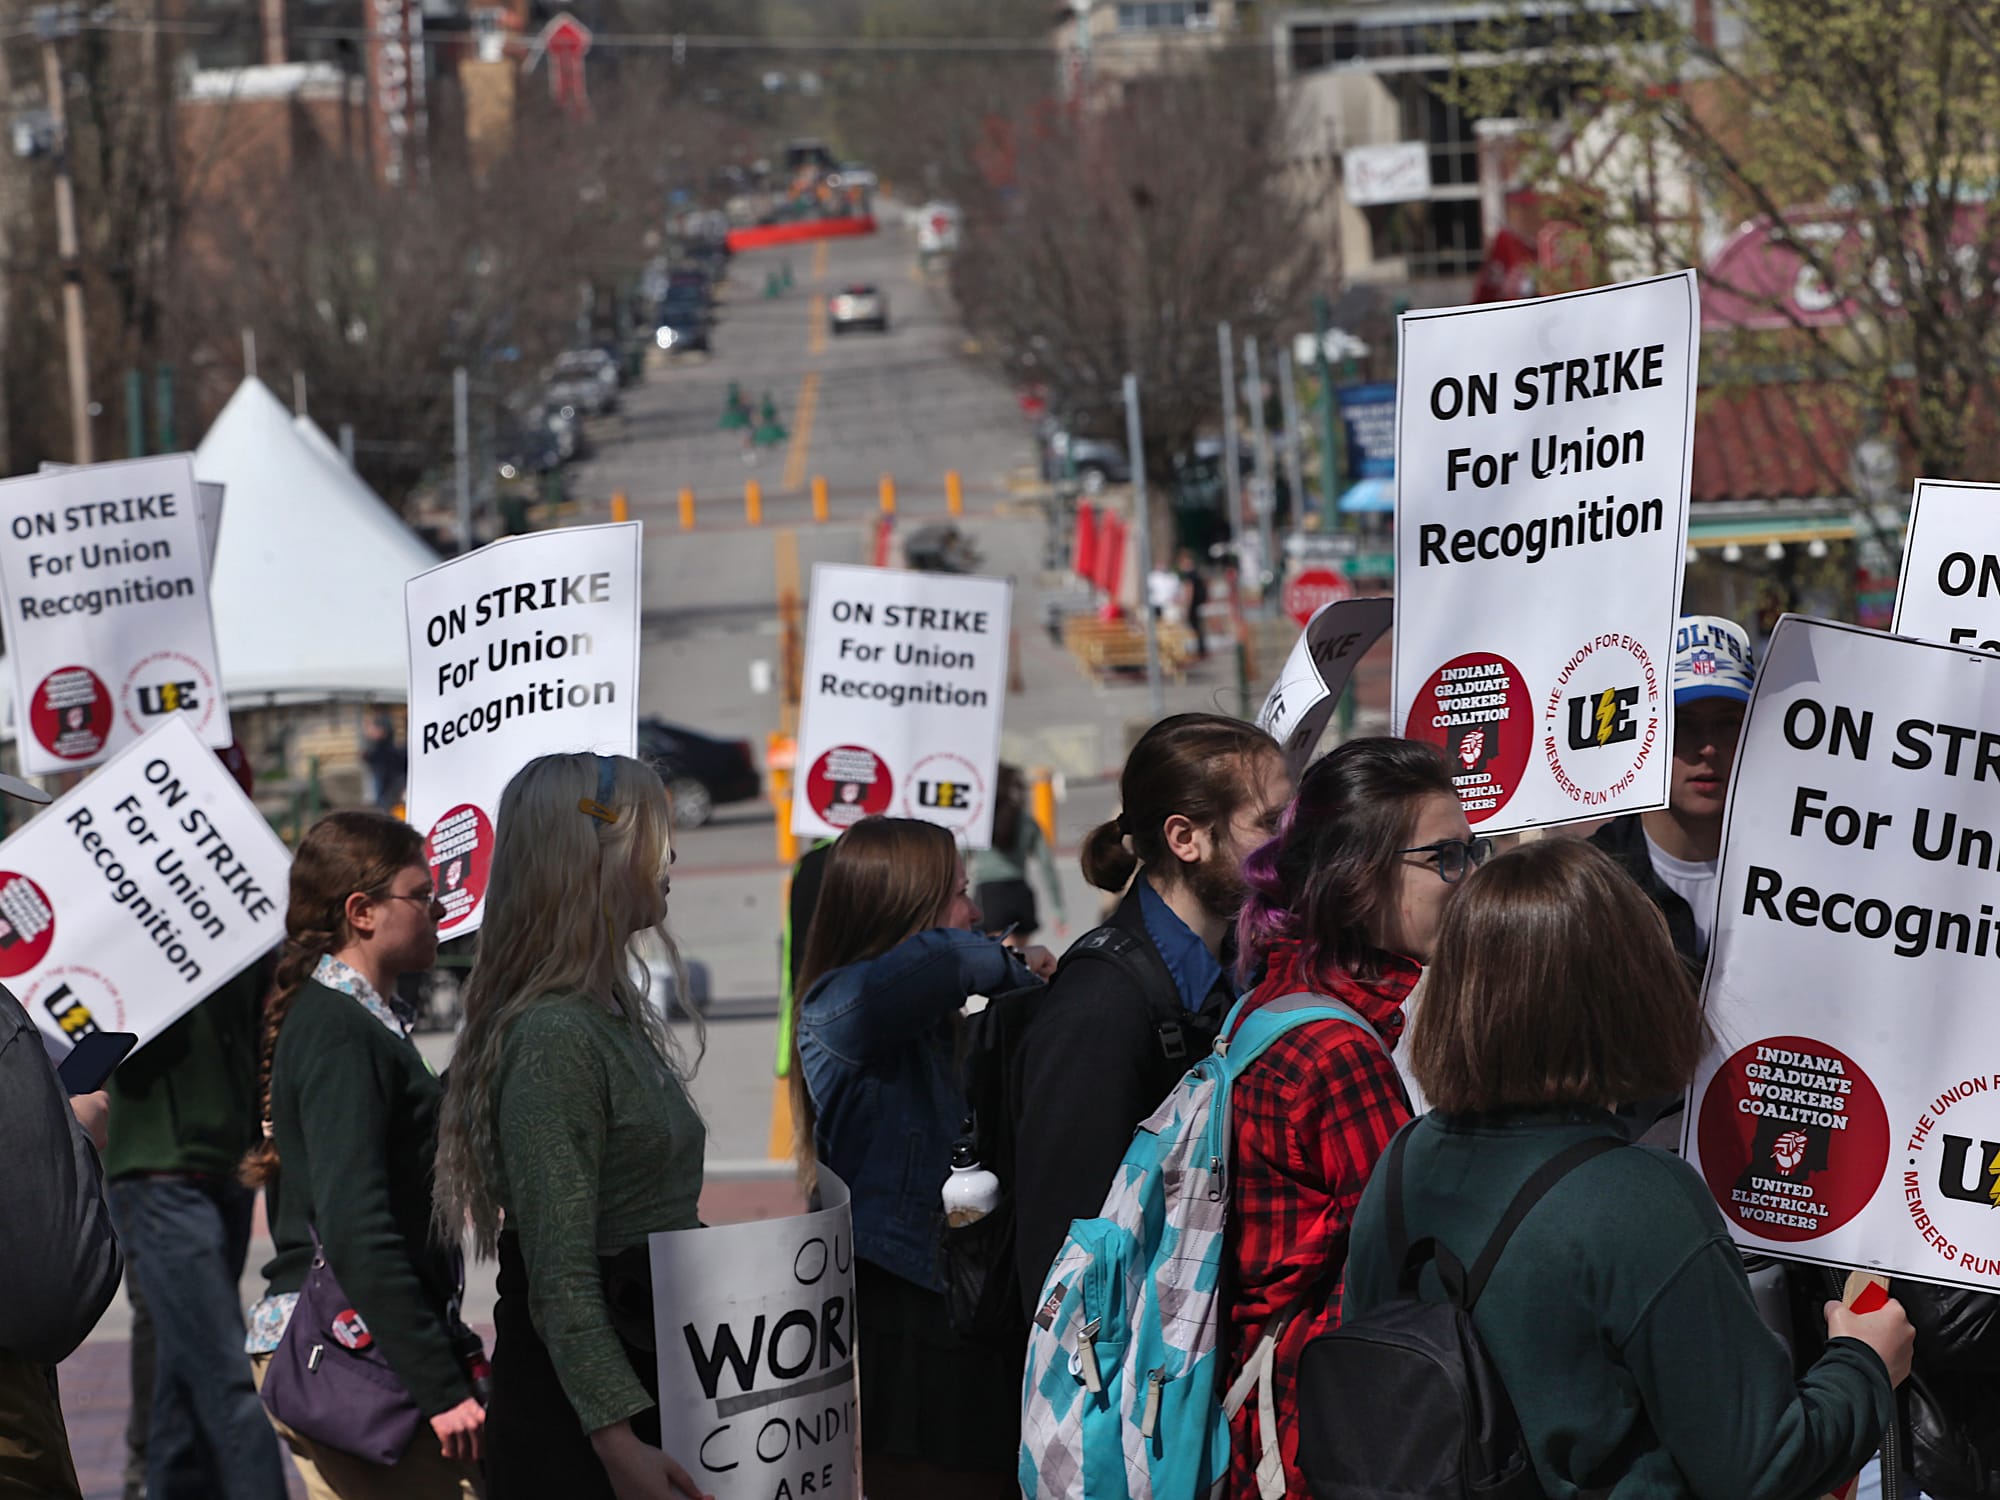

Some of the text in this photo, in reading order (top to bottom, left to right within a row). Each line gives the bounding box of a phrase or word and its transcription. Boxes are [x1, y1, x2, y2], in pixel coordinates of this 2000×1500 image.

[1430, 344, 1664, 420] ON STRIKE
[1447, 427, 1645, 491] For Union
[12, 493, 177, 540] ON STRIKE
[1419, 495, 1663, 567] Recognition
[29, 537, 171, 578] For Union
[1938, 551, 2000, 598] ON
[20, 575, 195, 621] Recognition
[427, 572, 611, 648] ON STRIKE
[832, 600, 988, 634] ON STRIKE
[439, 630, 593, 697] For Union
[840, 638, 975, 669] For Union
[1676, 623, 1742, 663] OLTS
[820, 673, 988, 707] Recognition
[1434, 677, 1510, 697] GRADUATE
[1441, 663, 1505, 681] INDIANA
[1545, 633, 1659, 721] THE UNION FOR EVERYONE
[136, 681, 198, 716] UE
[423, 679, 616, 755] Recognition
[1432, 707, 1510, 728] COALITION
[1437, 692, 1507, 712] WORKERS
[1568, 686, 1640, 751] UE
[1783, 699, 1873, 761] ON
[1545, 717, 1659, 805] MEMBERS RUN THIS UNION
[918, 780, 971, 809] UE
[1456, 784, 1504, 798] TRICAL
[1460, 798, 1497, 812] RKERS
[144, 758, 188, 808] ON
[180, 809, 277, 922] STRIKE
[1790, 786, 2000, 873] For Un
[114, 795, 226, 940] For Union
[66, 806, 204, 983] Recognition
[1742, 865, 2000, 958] Recogni
[1744, 1063, 1853, 1095] GRADUATE
[1755, 1046, 1845, 1075] INDIANA
[1738, 1099, 1849, 1130] COALITION
[1747, 1080, 1845, 1112] WORKERS
[1907, 1114, 1936, 1152] THE
[1930, 1075, 1988, 1116] UNION
[1751, 1177, 1814, 1198] UNITED
[1938, 1133, 2000, 1207] U
[1730, 1188, 1829, 1217] ELECTRICAL
[1738, 1205, 1818, 1230] WORKERS
[1904, 1170, 2000, 1277] MEMBERS RUN
[700, 1398, 857, 1472] CONDI
[774, 1463, 833, 1500] ARE
